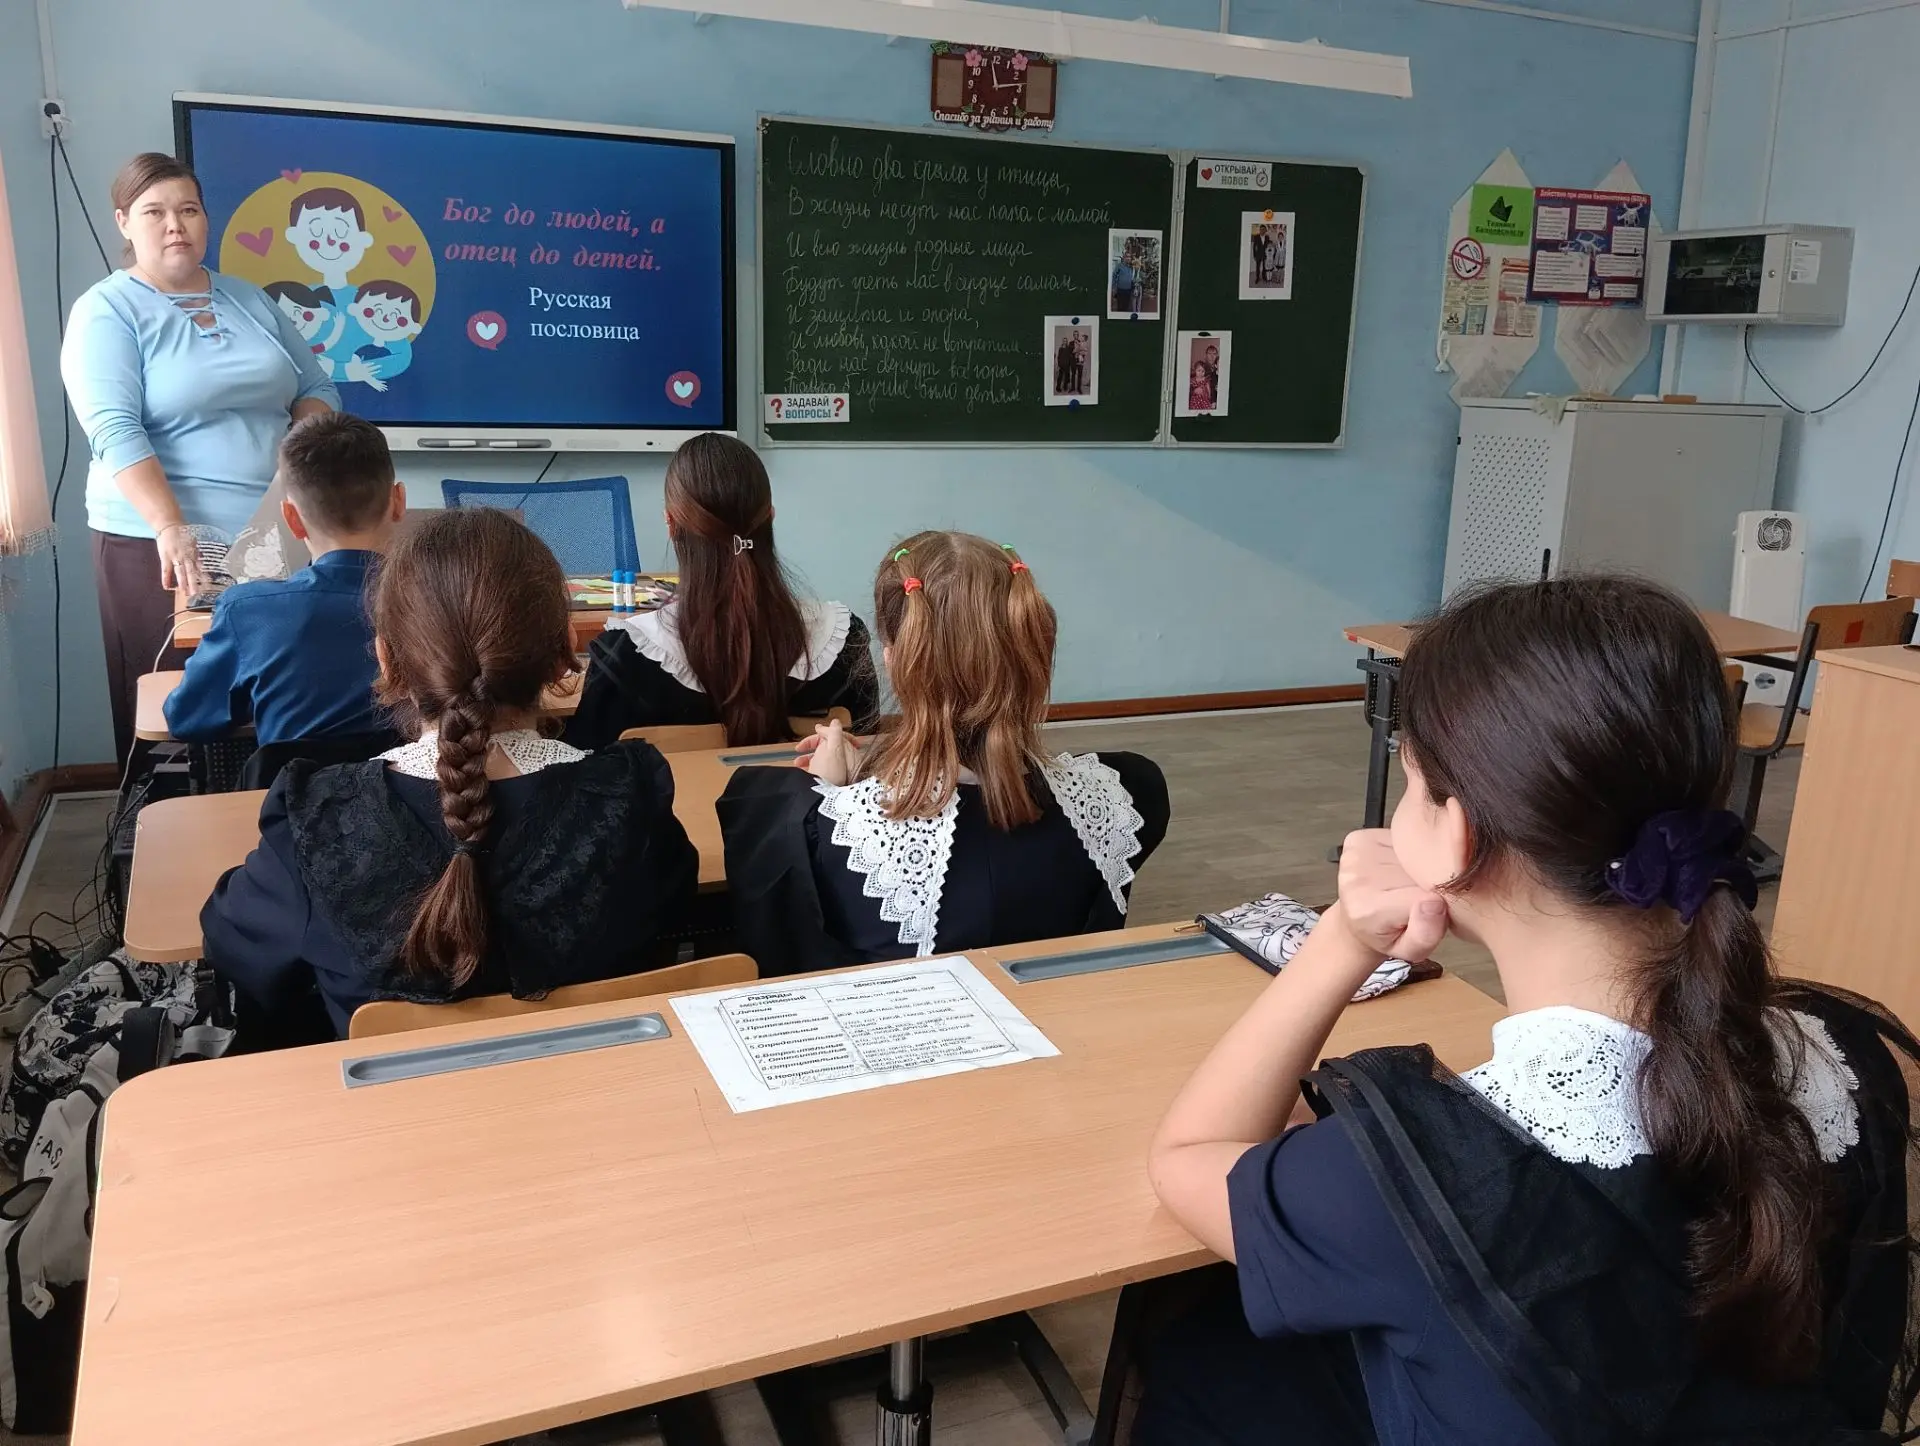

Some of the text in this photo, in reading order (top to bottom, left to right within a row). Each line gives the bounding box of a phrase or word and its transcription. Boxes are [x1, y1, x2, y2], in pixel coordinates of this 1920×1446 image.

[981, 58, 988, 67] 11
[993, 55, 1001, 65] 12
[1006, 60, 1010, 69] 1
[972, 67, 981, 76] 10
[1013, 71, 1019, 80] 2
[967, 79, 974, 89] 9
[971, 93, 977, 103] 8
[980, 104, 985, 114] 7
[990, 108, 997, 117] 6
[1003, 106, 1009, 115] 5
[934, 110, 1055, 132] Спасибо за знания и заботу
[788, 136, 1071, 199] Словно два крыла у птицы,
[1214, 164, 1257, 175] ОТКРЫВАЙ
[1221, 176, 1249, 186] НОВОЕ
[787, 185, 803, 216] В
[811, 199, 870, 229] жизнь
[879, 202, 939, 236] несут
[948, 204, 982, 222] нас
[988, 203, 1031, 223] папа
[443, 197, 666, 237] Бог до людей, а
[786, 232, 804, 257] И
[812, 229, 839, 256] всю
[847, 242, 907, 266] жизнь
[444, 242, 661, 271] отец до детей.
[783, 265, 844, 306] Будут
[528, 286, 611, 311] Русская
[786, 304, 802, 324] И
[805, 307, 892, 336] защита
[530, 323, 640, 342] пословица
[790, 332, 806, 350] И
[787, 395, 829, 407] ЗАДАВАЙ
[785, 409, 831, 419] ВОПРОСЫ
[739, 996, 806, 1006] местоимений
[747, 992, 791, 1001] Разряды
